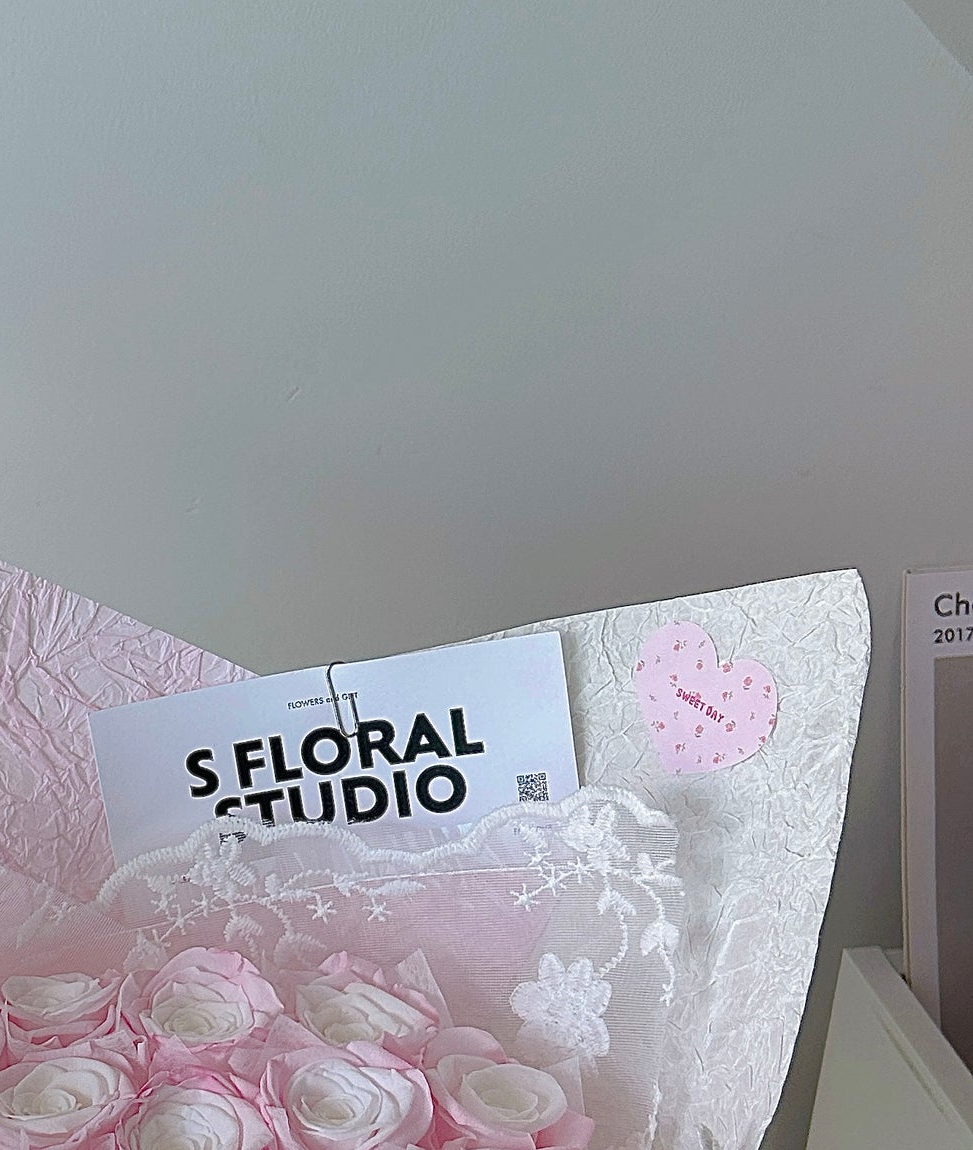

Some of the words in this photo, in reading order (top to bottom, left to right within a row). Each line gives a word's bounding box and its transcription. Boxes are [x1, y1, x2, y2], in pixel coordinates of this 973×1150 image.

[934, 591, 973, 617] Ch
[933, 626, 973, 644] 2017
[287, 697, 324, 710] FLOWERS
[675, 687, 707, 712] SWEET
[705, 705, 725, 723] DAY
[185, 748, 220, 799] S
[232, 707, 485, 790] FLORAL
